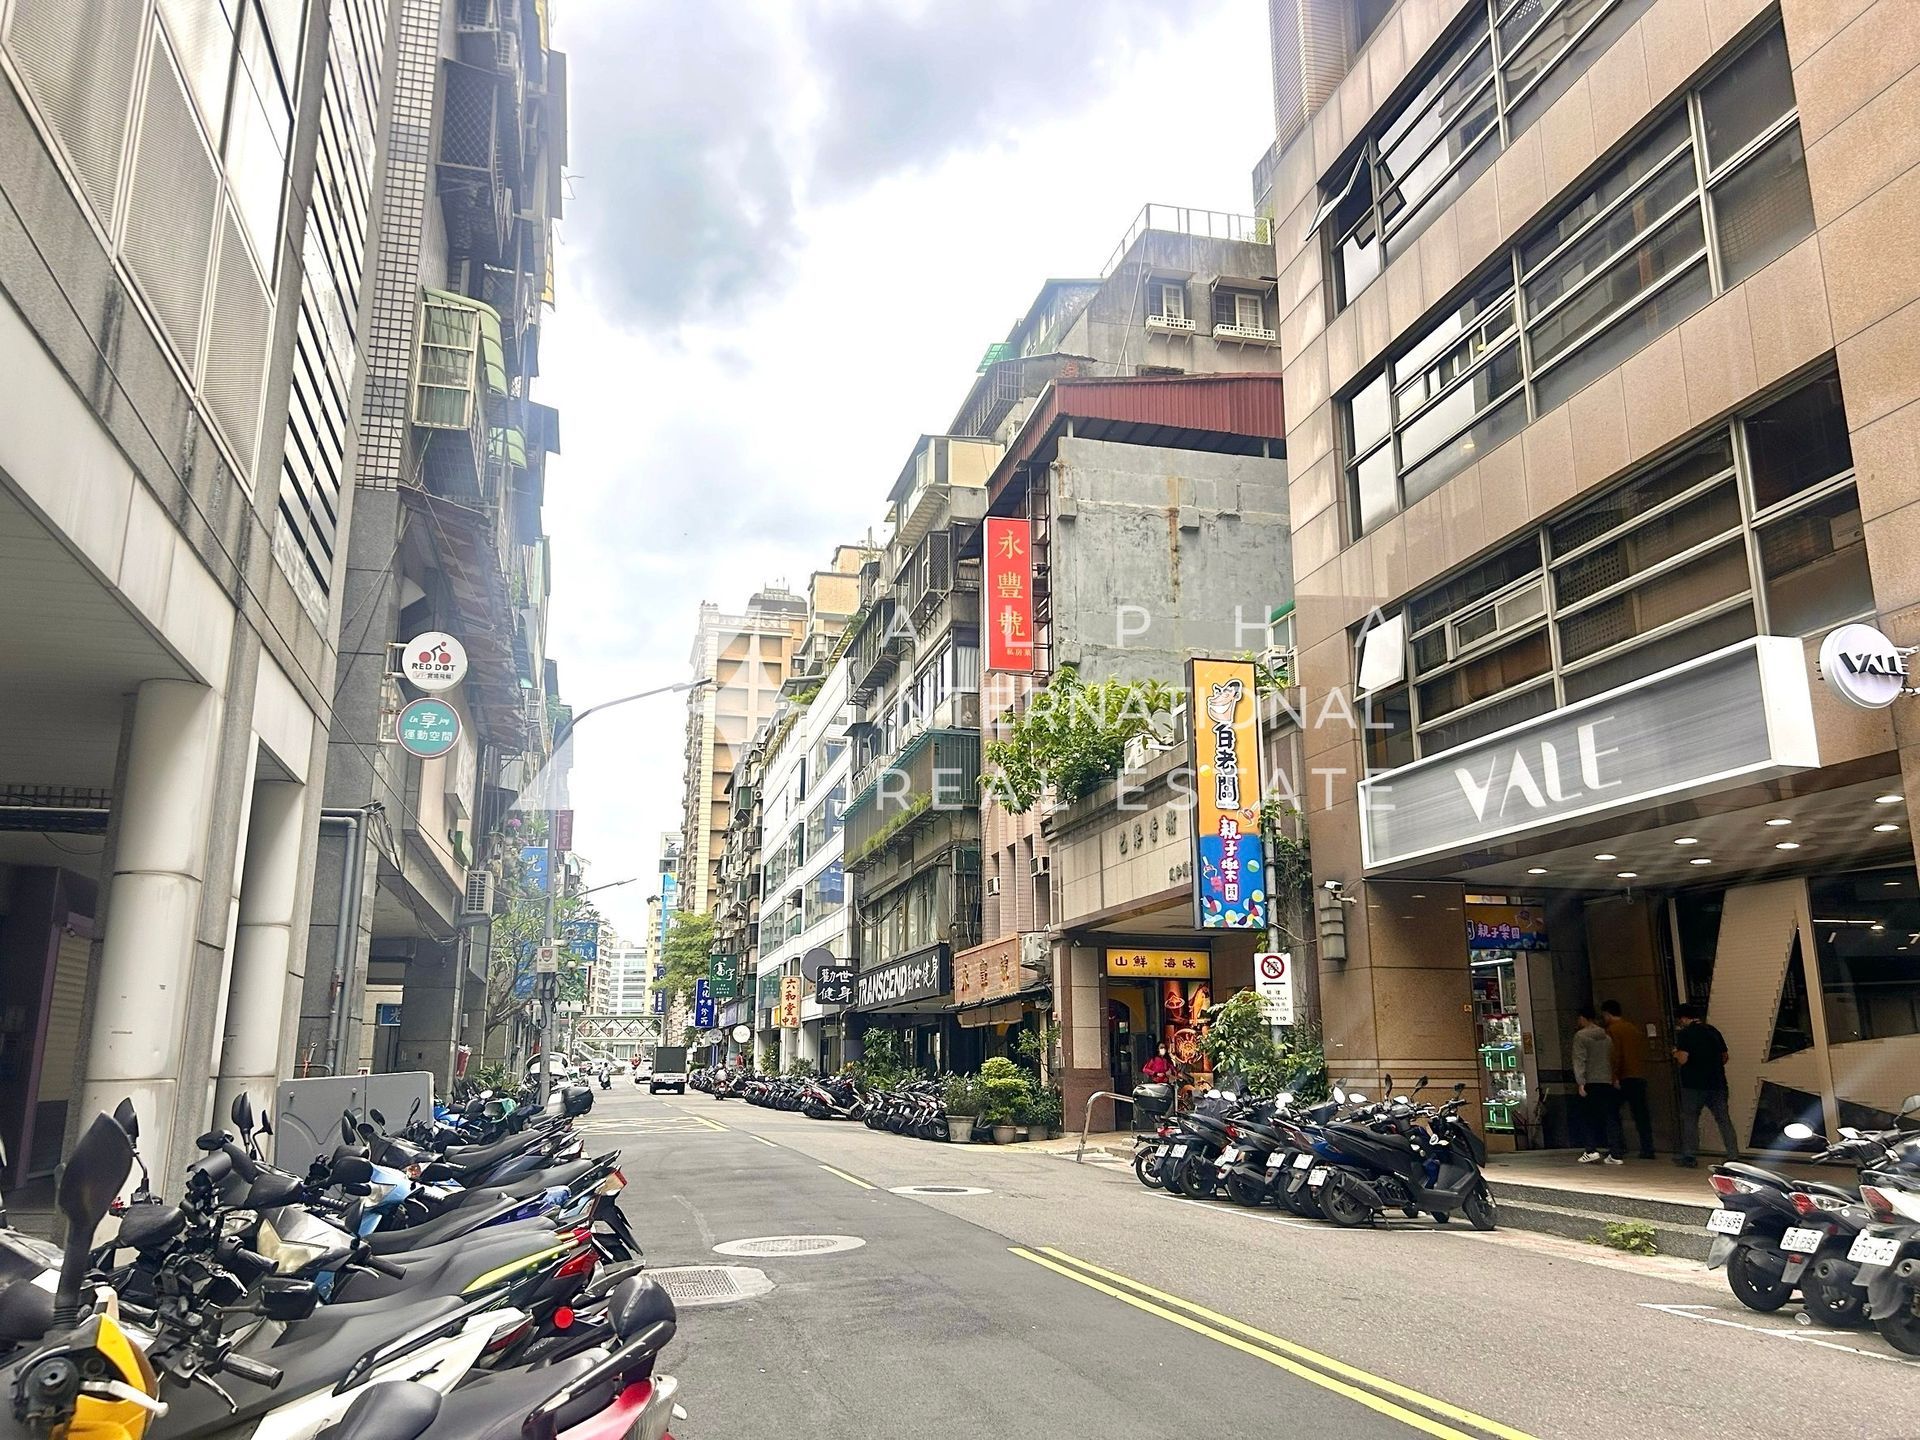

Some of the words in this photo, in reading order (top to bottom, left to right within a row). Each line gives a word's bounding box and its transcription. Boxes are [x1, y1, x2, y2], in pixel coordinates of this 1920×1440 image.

[994, 529, 1026, 637] 永豐號
[411, 662, 432, 670] RED
[1838, 651, 1910, 676] VALE
[403, 729, 453, 742] 運動空間
[419, 711, 438, 729] 享
[1214, 724, 1239, 802] 白老闆
[1454, 715, 1622, 824] VALE
[1219, 816, 1242, 903] 親子樂園
[1477, 922, 1521, 941] 親子樂園
[858, 964, 909, 1008] TRANSCEND
